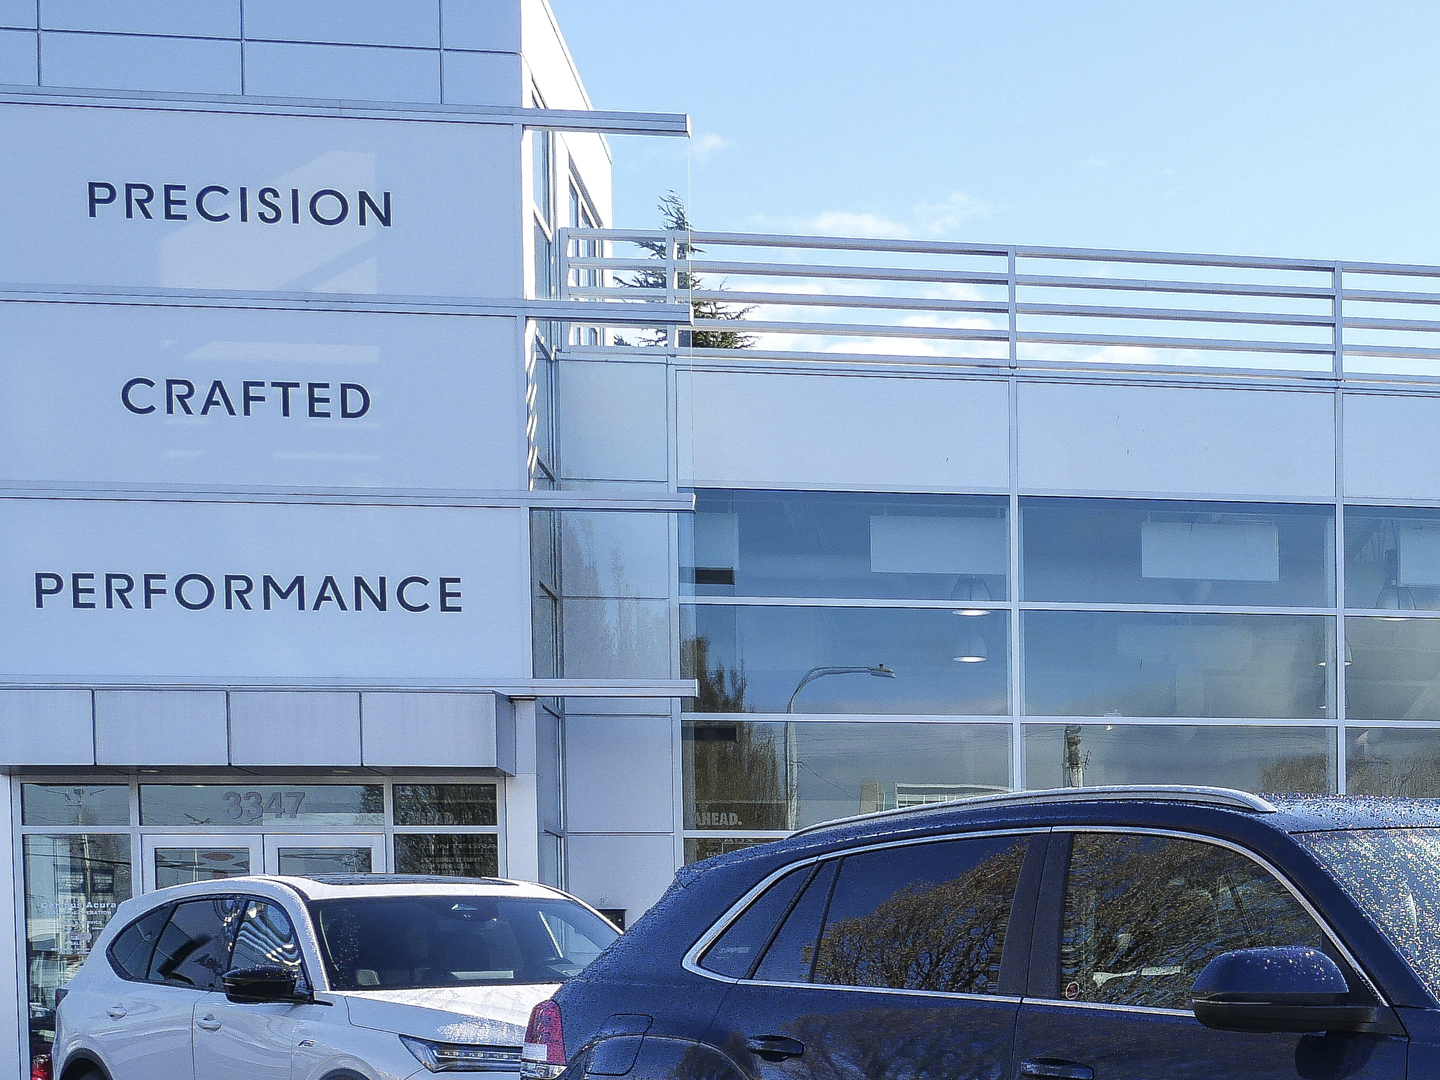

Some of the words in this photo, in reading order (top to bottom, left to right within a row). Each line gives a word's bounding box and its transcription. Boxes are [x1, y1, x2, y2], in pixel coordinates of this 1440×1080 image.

[87, 181, 392, 228] PRECISION
[120, 377, 371, 419] CRAFTED
[34, 572, 463, 613] PERFORMANCE
[222, 790, 306, 820] 3347
